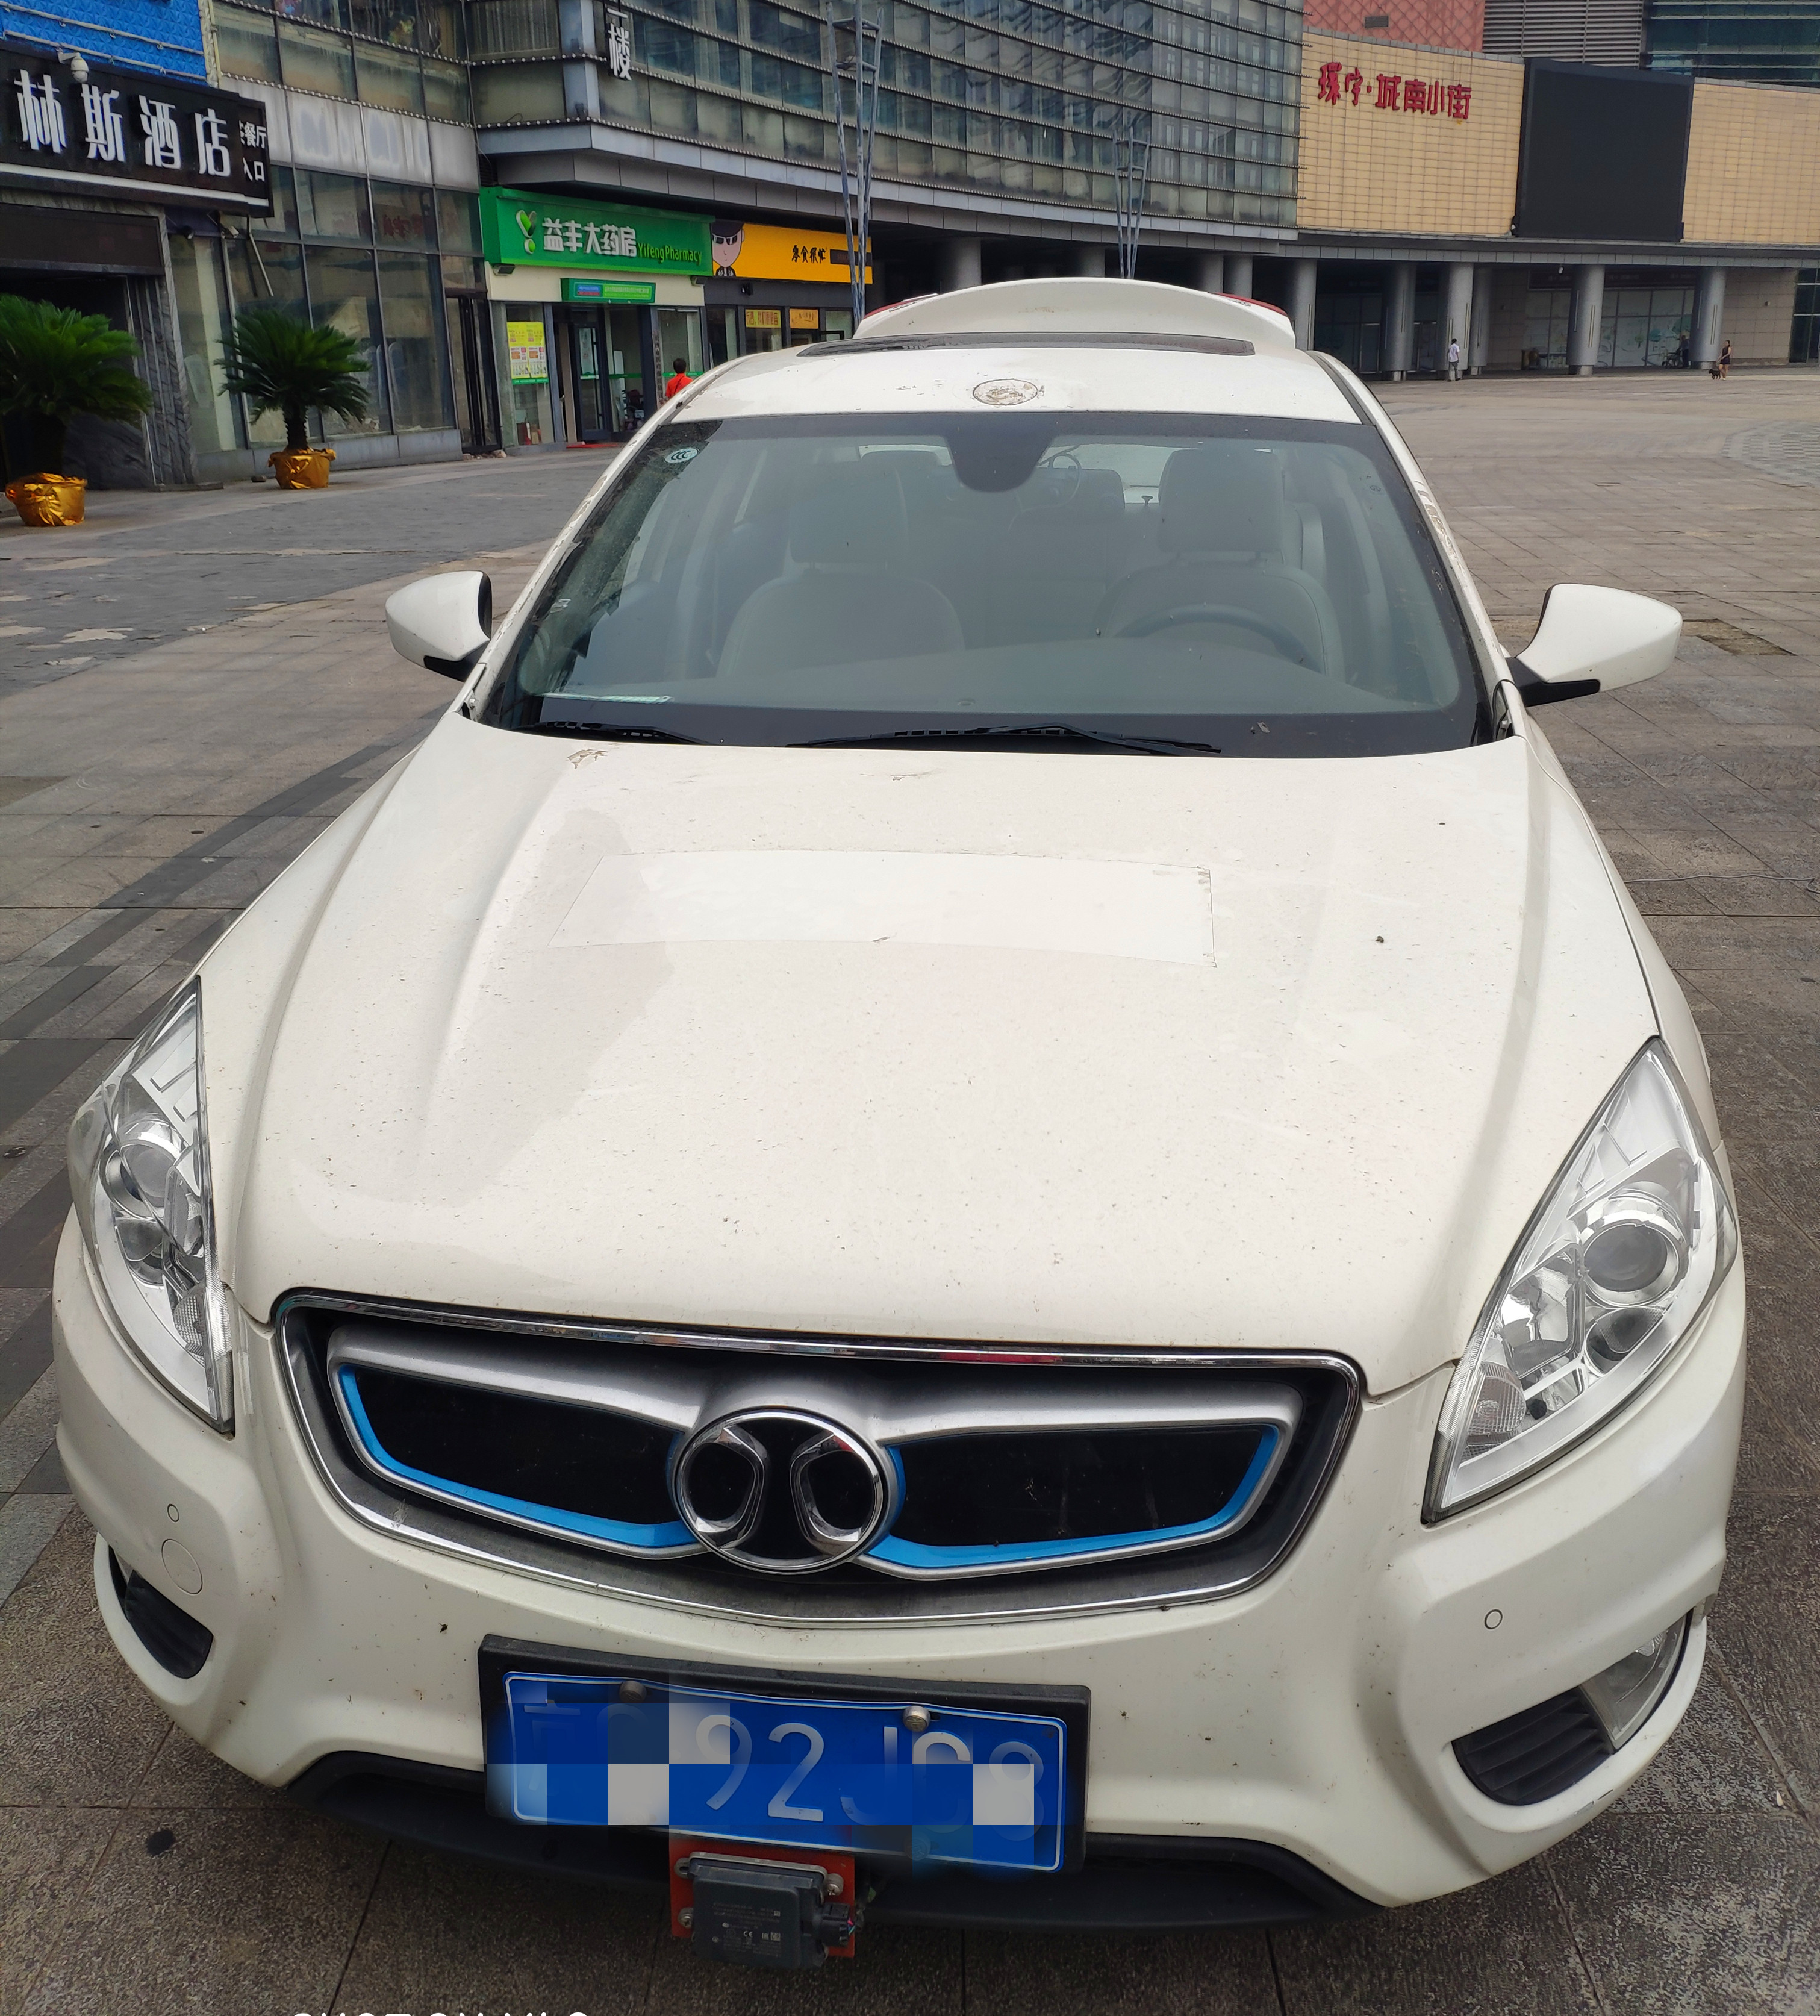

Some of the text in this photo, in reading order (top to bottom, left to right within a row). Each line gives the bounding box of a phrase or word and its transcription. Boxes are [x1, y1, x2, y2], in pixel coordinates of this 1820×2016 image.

[14, 69, 232, 177] 林斯酒店
[242, 157, 265, 182] 入口
[542, 217, 637, 257] 益丰大药房
[637, 242, 702, 265] Yifeng Pharmacy
